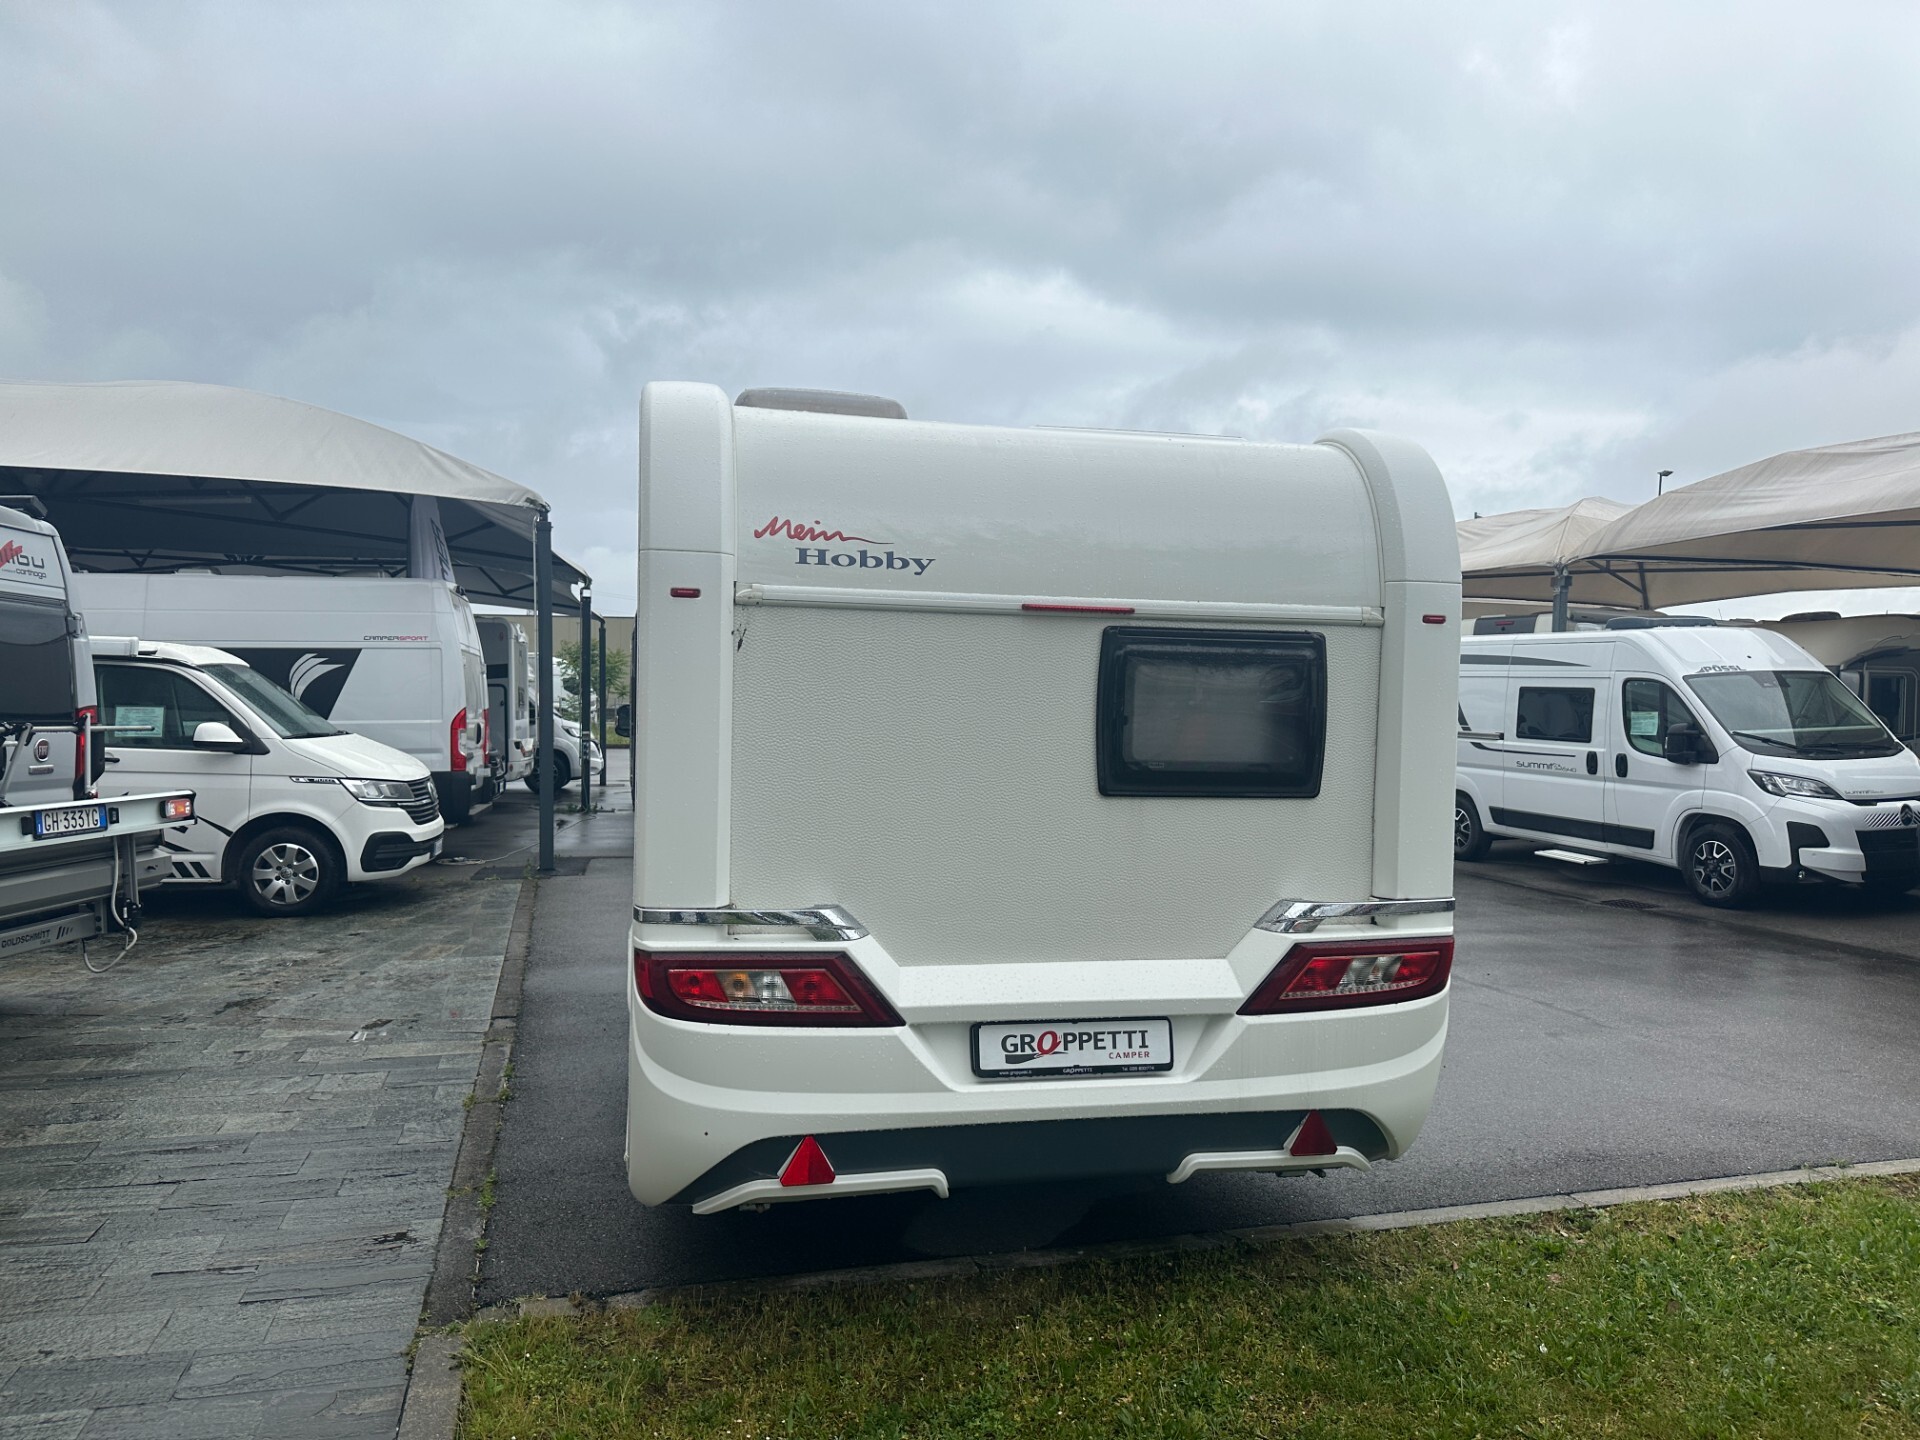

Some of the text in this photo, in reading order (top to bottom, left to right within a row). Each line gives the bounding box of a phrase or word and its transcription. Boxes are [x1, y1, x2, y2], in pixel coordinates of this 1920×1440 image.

[754, 516, 894, 545] Mein
[795, 547, 936, 576] Hobby
[1001, 1030, 1149, 1056] GROPPETTI
[1109, 1051, 1151, 1060] CAMPER
